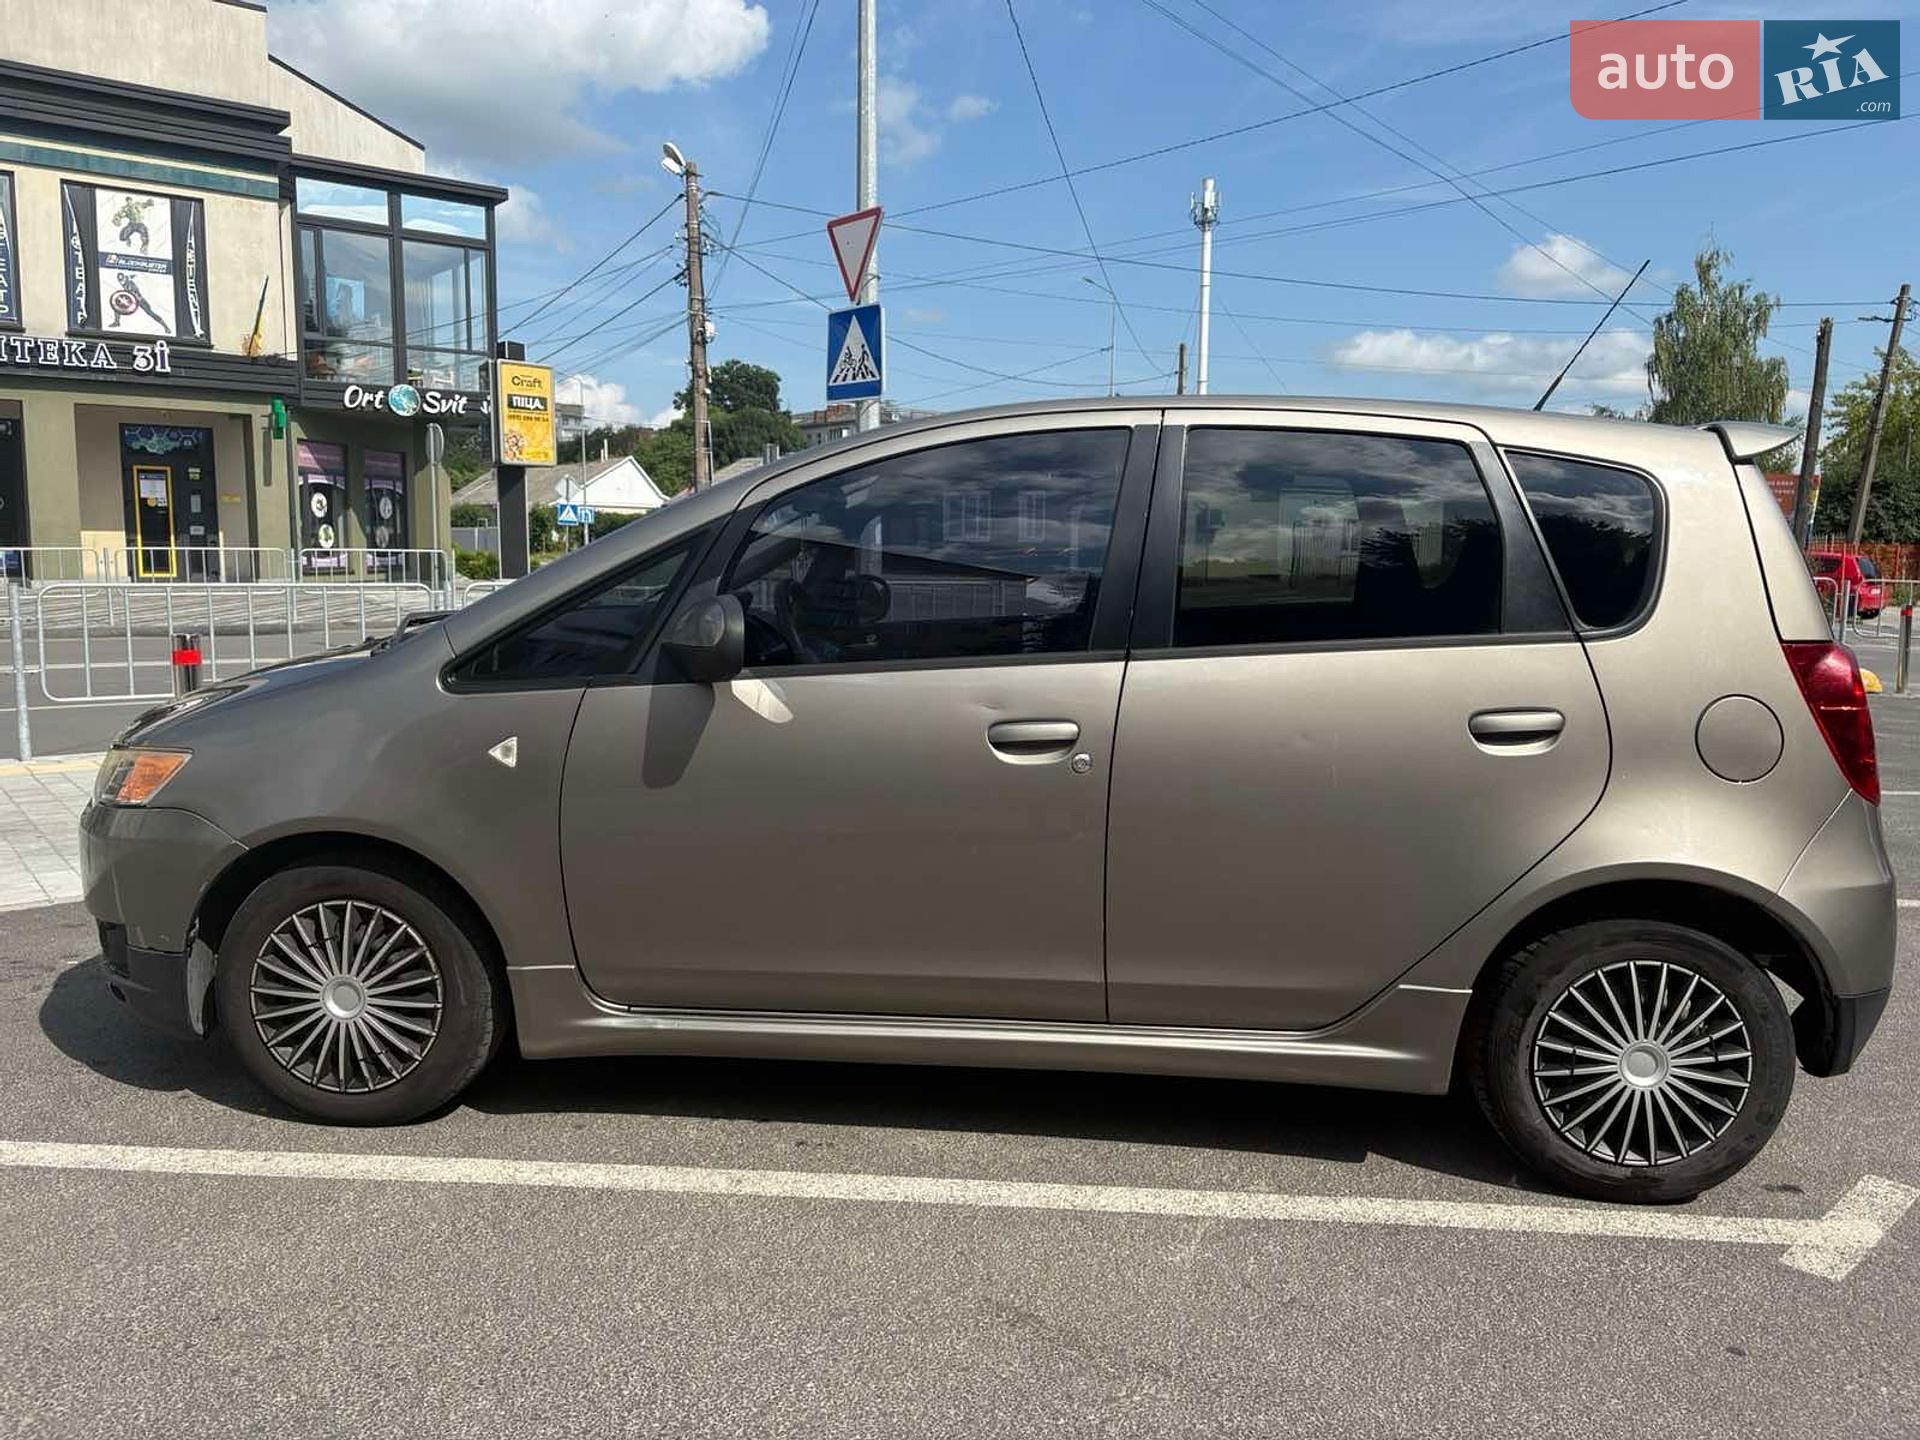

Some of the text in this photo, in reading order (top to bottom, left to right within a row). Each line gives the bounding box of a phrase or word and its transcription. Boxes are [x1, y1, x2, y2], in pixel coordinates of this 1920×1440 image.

[511, 375, 543, 389] Craft
[343, 385, 384, 409] Ort
[422, 391, 469, 414] Svit
